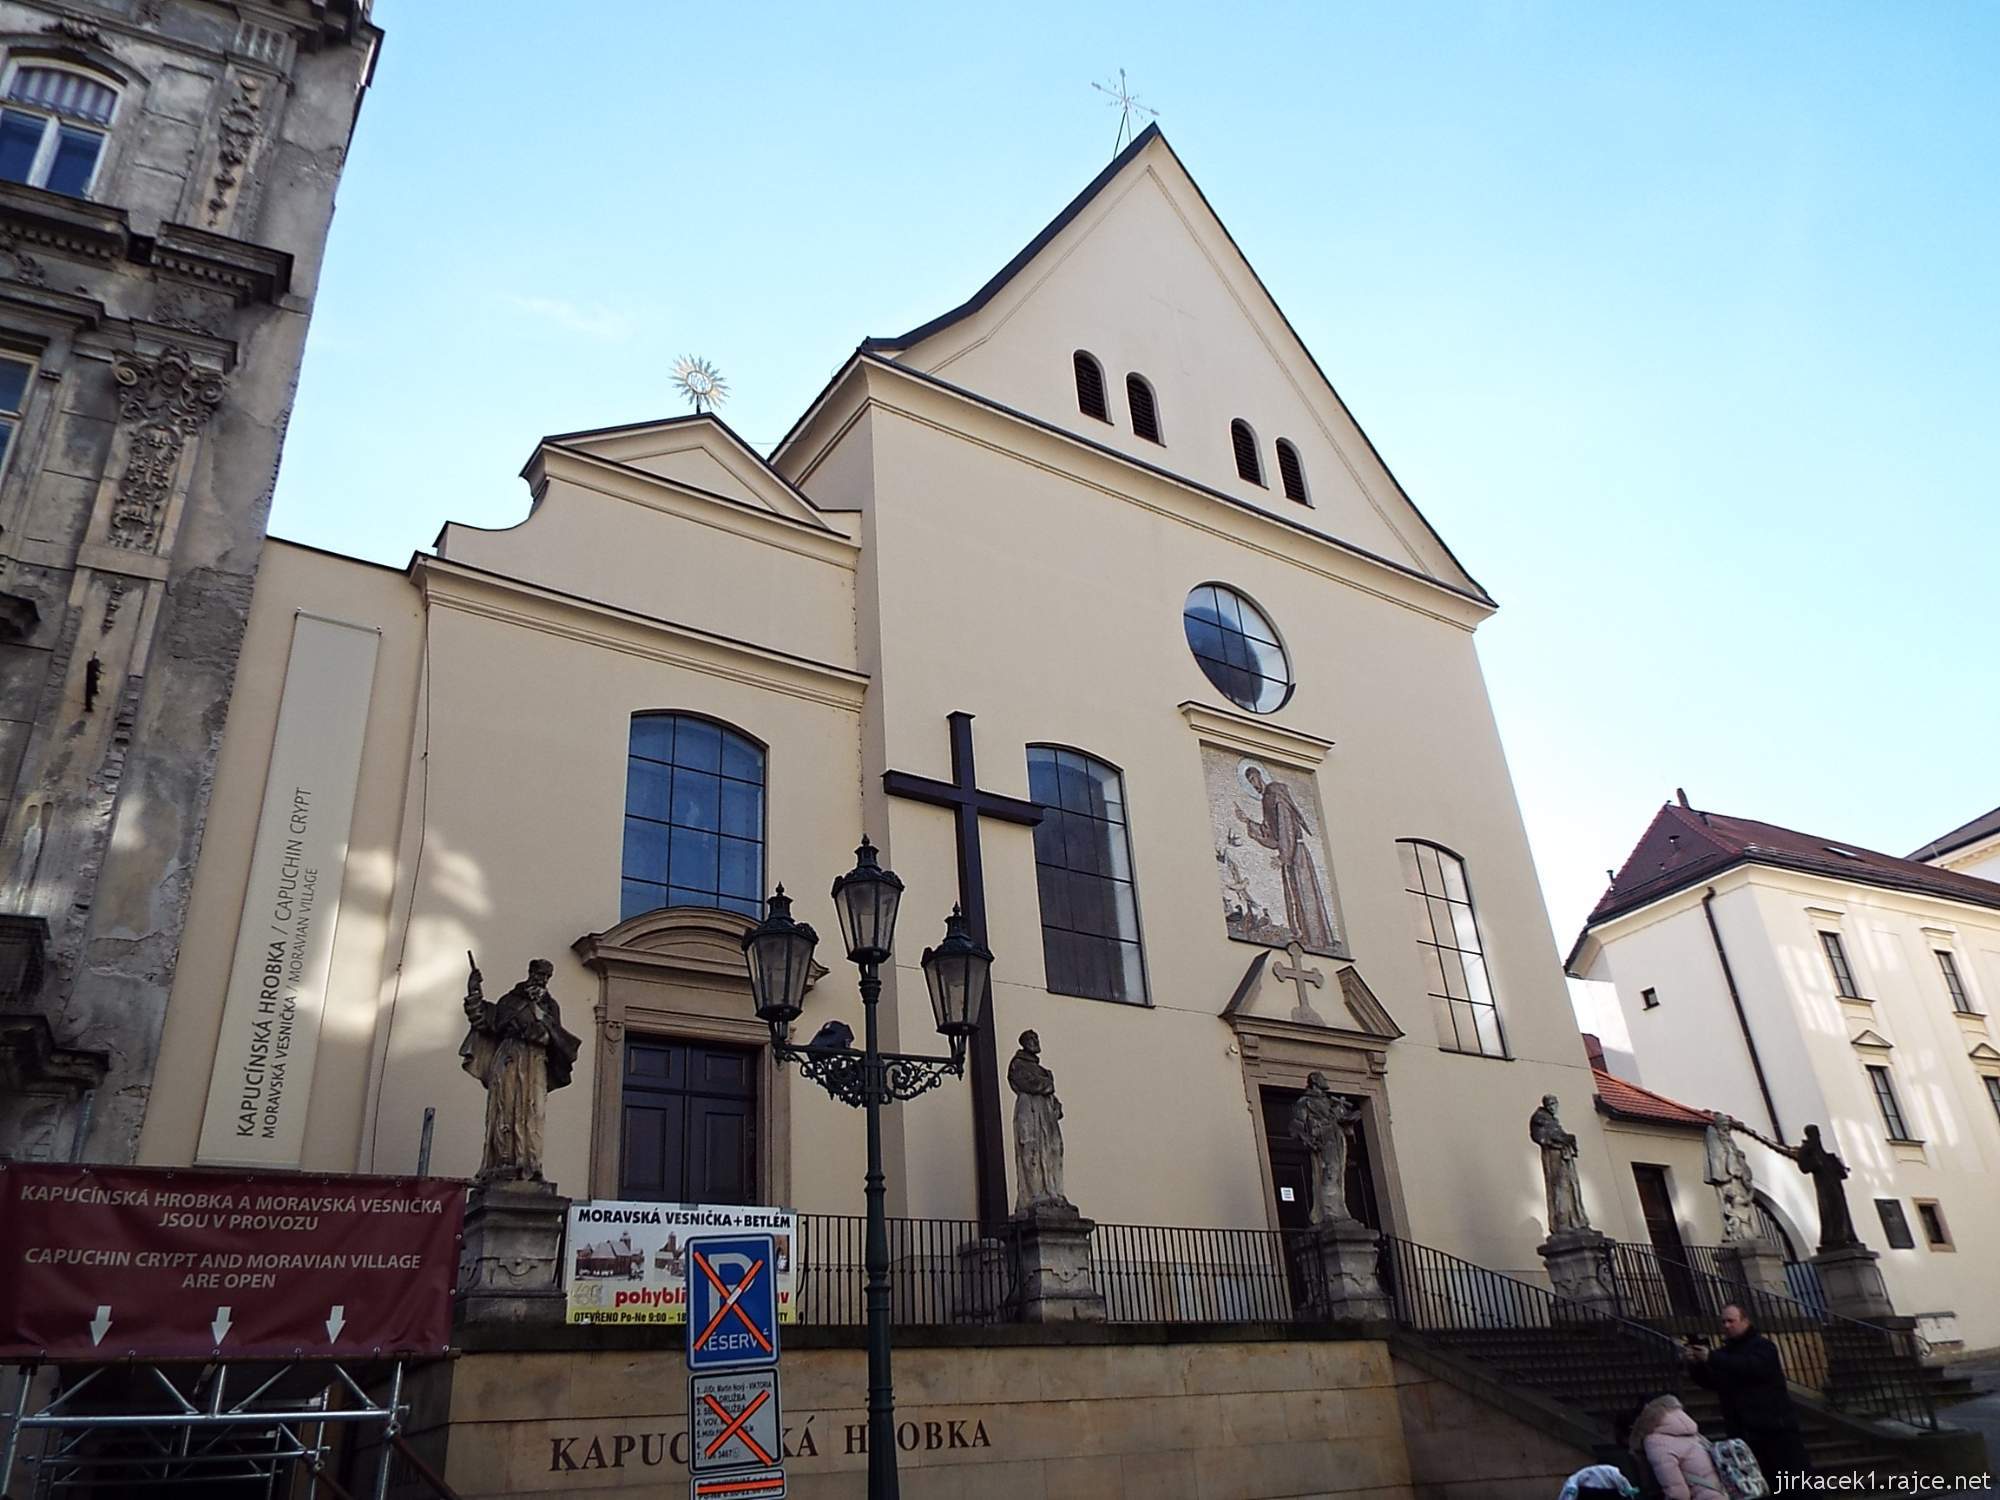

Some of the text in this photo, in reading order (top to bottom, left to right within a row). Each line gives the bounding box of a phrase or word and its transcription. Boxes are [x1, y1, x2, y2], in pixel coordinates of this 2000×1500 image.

[236, 787, 312, 1136] KAPUCÍNSKÁ HROBKA / CAPUCHIN CRYPT
[262, 867, 318, 1139] MORAVSKÁ VESNIČKA / MORAVIAN VILLAGE
[20, 1185, 443, 1214] KAPUCÍNSKÁ HROBKA A MORAVSKÁ VESNIČKA
[158, 1212, 319, 1231] JSOU V PROVOZU
[578, 1207, 661, 1224] MORAVSKÁ
[24, 1248, 421, 1269] CAPUCHIN CRYPT AND MORAVIAN VILLAGE
[181, 1273, 277, 1289] ARE OPEN
[614, 1286, 687, 1308] pohybli
[574, 1311, 618, 1323] OTEVŘENO
[620, 1312, 647, 1322] Po-Ne
[648, 1312, 667, 1322] 9:00
[844, 1419, 991, 1454] HOBKA
